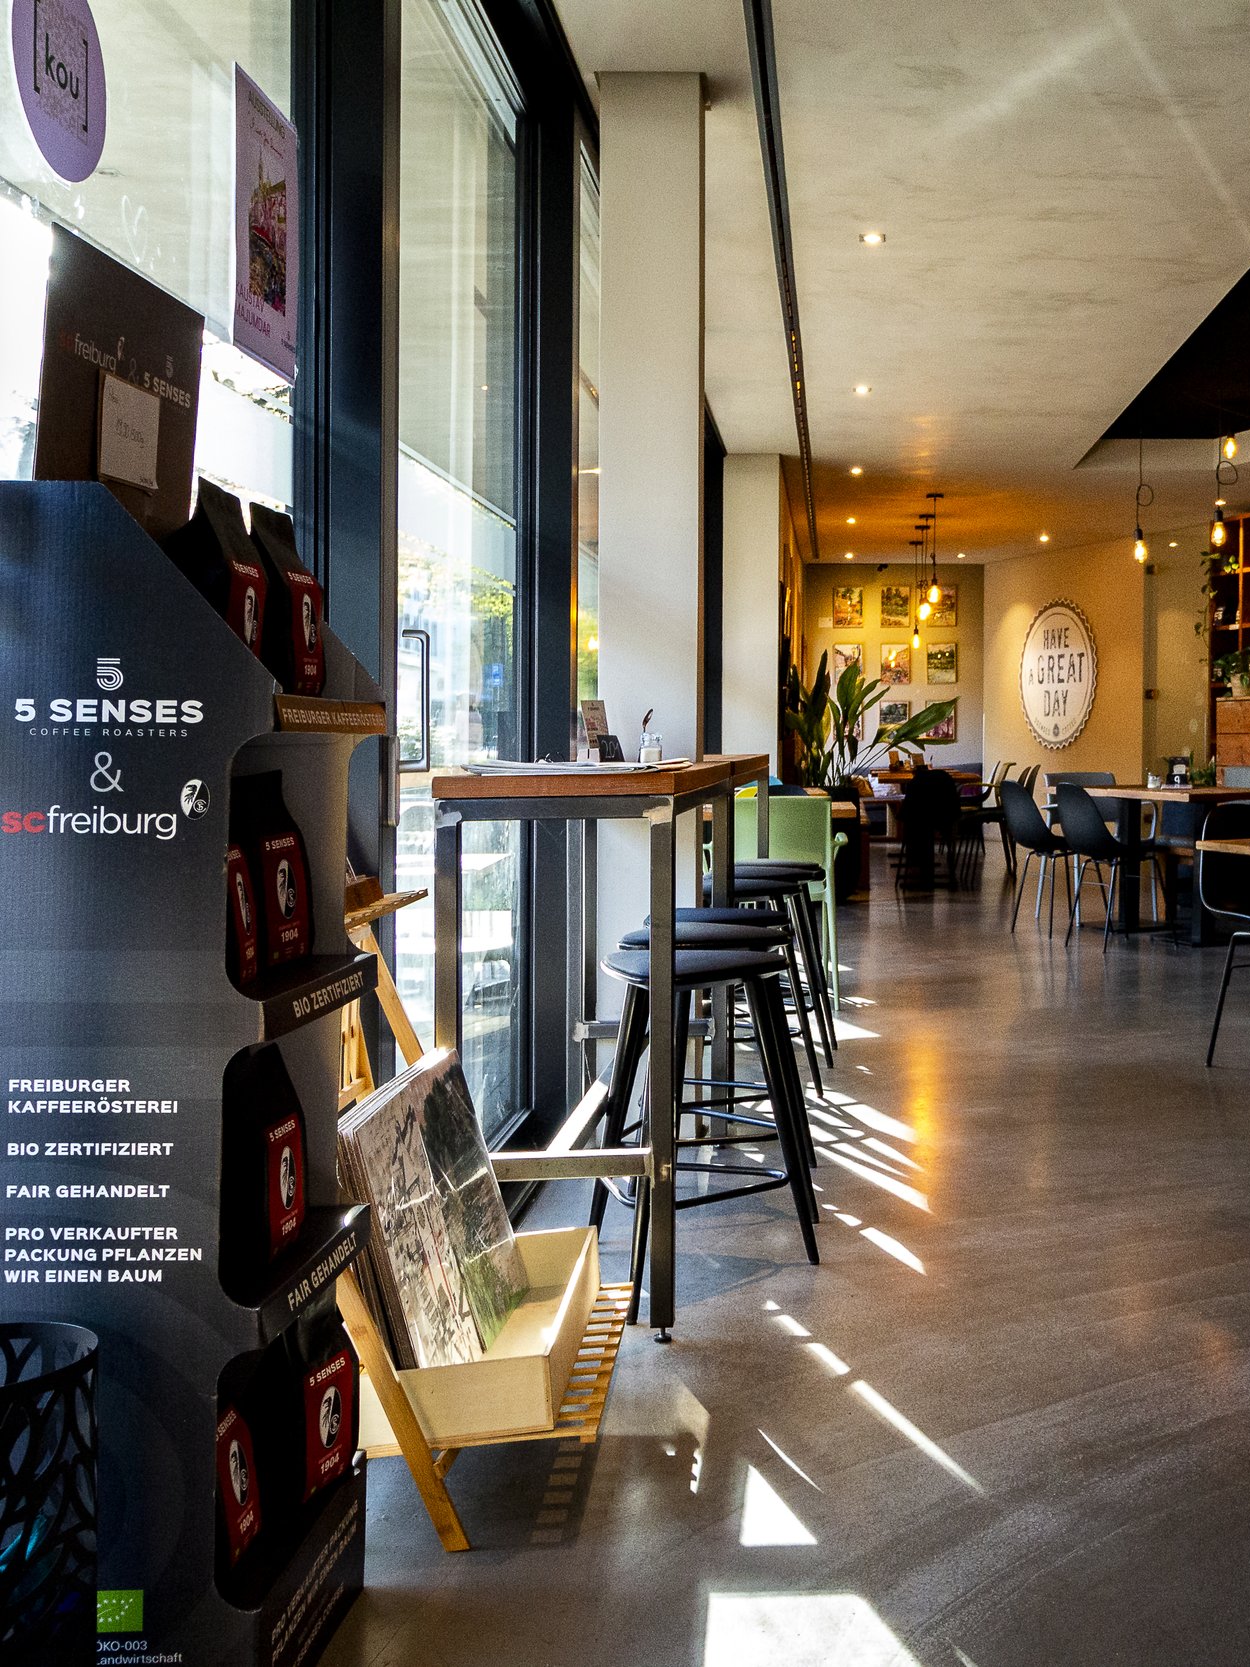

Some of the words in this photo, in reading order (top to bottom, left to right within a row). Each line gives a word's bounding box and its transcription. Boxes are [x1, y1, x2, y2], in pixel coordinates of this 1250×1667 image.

[45, 33, 79, 100] kou
[143, 371, 151, 388] 5
[153, 376, 191, 408] SENSES
[237, 564, 259, 578] SENSES
[293, 574, 314, 584] SENSES
[1043, 627, 1070, 650] HAVE
[1028, 668, 1034, 685] A
[1037, 652, 1085, 684] GREAT
[14, 699, 36, 723] 5
[50, 699, 204, 724] SENSES
[1043, 690, 1069, 717] DAY
[282, 708, 332, 725] FREIBURGER
[29, 728, 91, 737] COFFEE
[102, 728, 189, 738] ROASTERS
[90, 751, 125, 793] &
[1, 805, 178, 841] scfreiburg
[265, 841, 271, 851] 5
[271, 836, 295, 850] SENSES
[281, 928, 299, 943] 1904
[292, 996, 311, 1018] BIO
[310, 971, 364, 1010] ZERTIFIZIERT
[8, 1079, 131, 1093] FREIBURGER
[7, 1096, 179, 1115] KAFFEERÖSTEREI
[269, 1131, 274, 1142] 5
[274, 1119, 295, 1140] SENSES
[6, 1143, 40, 1156] BIO
[44, 1143, 174, 1156] ZERTIFIZIERT
[6, 1185, 51, 1199] FAIR
[56, 1184, 171, 1199] GEHANDELT
[5, 1227, 45, 1241] PRO
[50, 1227, 179, 1241] VERKAUFTER
[281, 1221, 297, 1236] 1904
[4, 1248, 97, 1262] PACKUNG
[102, 1248, 203, 1262] PFLANZEN
[3, 1269, 39, 1283] WIR
[44, 1269, 102, 1283] EINEN
[107, 1269, 163, 1283] BAUM
[287, 1275, 312, 1311] FAIR
[311, 1231, 358, 1288] GEHANDELT
[309, 1377, 315, 1387] 5
[316, 1356, 346, 1382] SENSES
[320, 1452, 340, 1474] 1904
[240, 1510, 254, 1534] 1904
[97, 1652, 183, 1666] andwirtschaft
